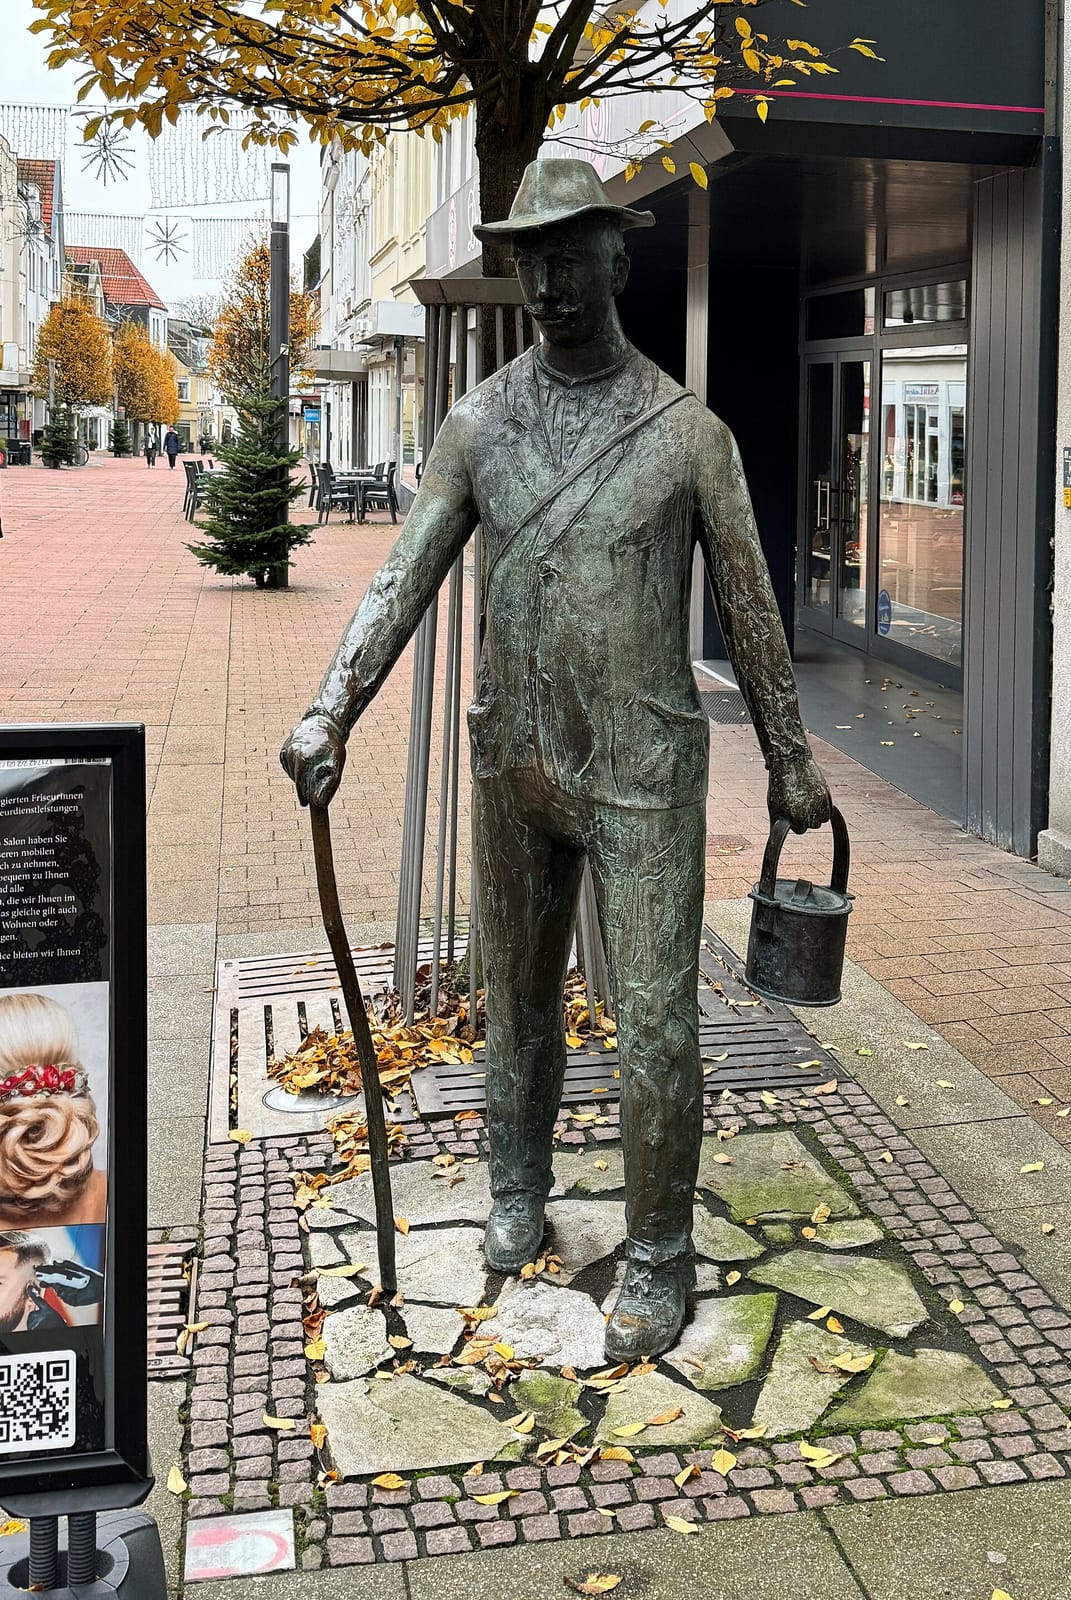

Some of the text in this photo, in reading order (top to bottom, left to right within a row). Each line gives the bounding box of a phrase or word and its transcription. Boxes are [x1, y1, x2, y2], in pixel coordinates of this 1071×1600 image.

[31, 793, 84, 801] FriseurInnen
[3, 834, 68, 846] Salon haben Sie
[21, 847, 55, 857] mobilen
[45, 870, 69, 879] Ihnen
[9, 883, 25, 893] alle
[6, 896, 20, 905] die
[21, 896, 36, 904] wir
[38, 894, 62, 904] Ihnen
[64, 894, 76, 902] im
[11, 907, 41, 919] gleiche
[42, 906, 56, 917] gilt
[57, 905, 77, 914] auch
[1, 918, 59, 929] Wohnen oder
[13, 950, 39, 960] bieten
[41, 949, 55, 957] wir
[56, 948, 81, 957] Ihnen
